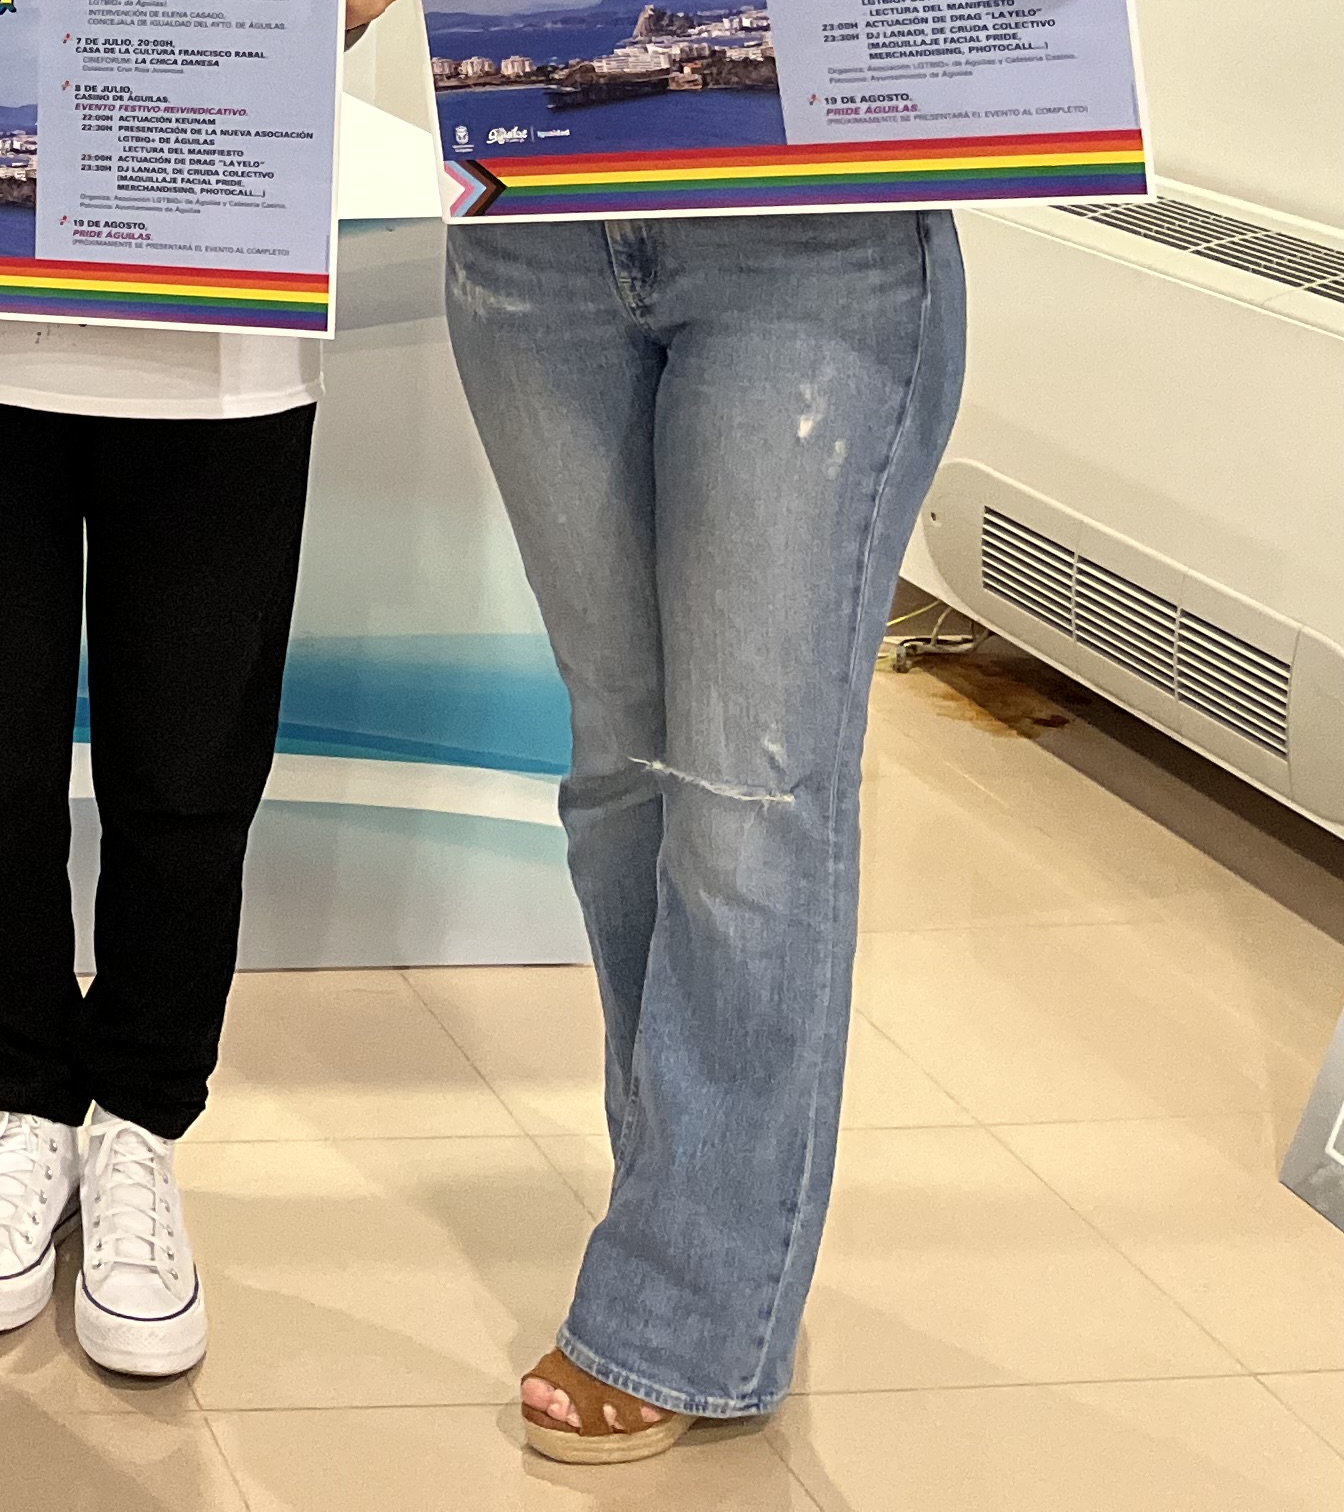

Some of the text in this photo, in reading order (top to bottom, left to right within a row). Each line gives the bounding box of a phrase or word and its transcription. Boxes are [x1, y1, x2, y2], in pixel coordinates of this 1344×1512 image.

[76, 37, 81, 45] 7
[84, 37, 99, 45] DE
[823, 96, 838, 105] 19
[840, 95, 857, 104] DE
[189, 127, 202, 135] DE
[73, 219, 84, 227] 19
[87, 219, 100, 228] DE
